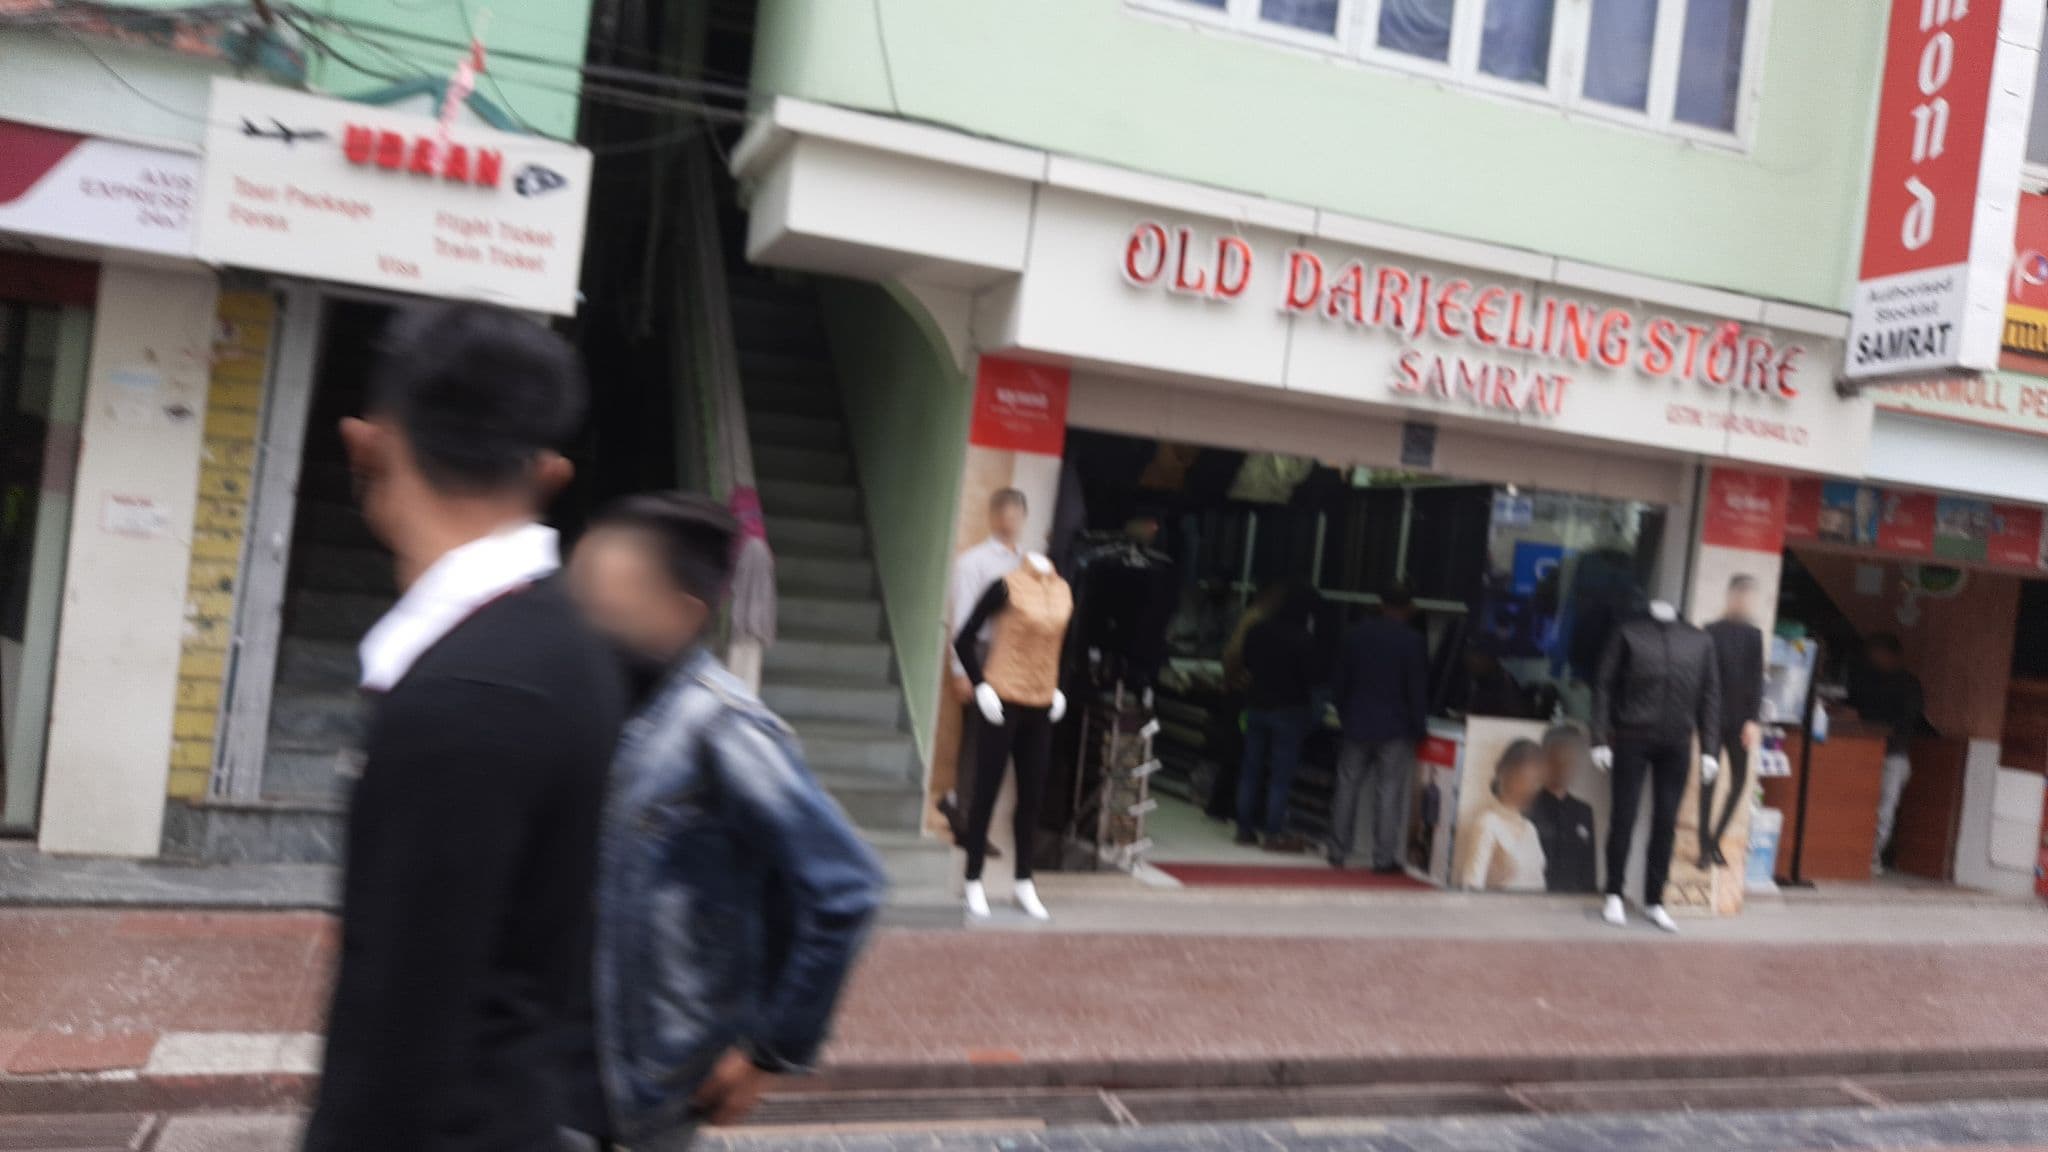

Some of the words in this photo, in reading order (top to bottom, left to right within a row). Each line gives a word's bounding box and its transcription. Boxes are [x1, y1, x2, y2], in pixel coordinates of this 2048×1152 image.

[343, 120, 503, 189] UDAAN
[285, 185, 374, 222] Package
[498, 221, 556, 249] Ticket
[488, 246, 546, 273] Ticket
[1125, 222, 1254, 299] OLD
[1285, 250, 1633, 367] DARJEELING
[1643, 314, 1806, 399] STORE
[1856, 322, 1953, 364] SAMRAT
[1396, 349, 1574, 416] SAMRAT
